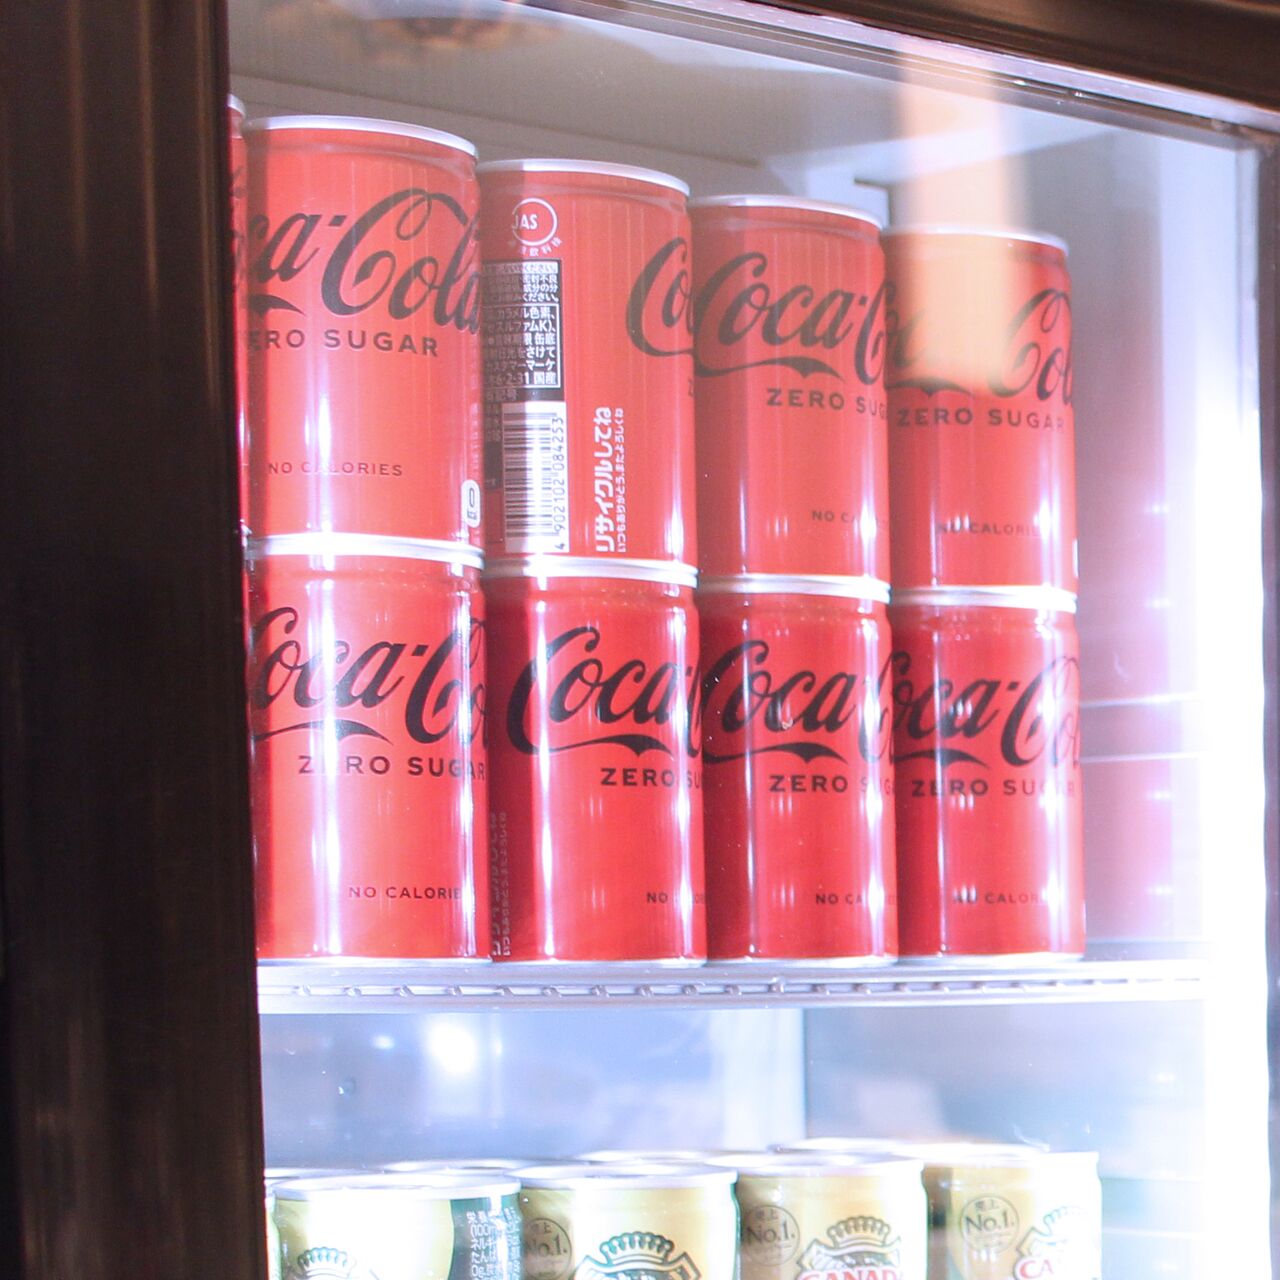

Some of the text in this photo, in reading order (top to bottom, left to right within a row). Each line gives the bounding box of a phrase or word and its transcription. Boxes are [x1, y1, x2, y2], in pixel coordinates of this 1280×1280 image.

[324, 330, 438, 358] SUGAR
[766, 388, 846, 411] ZERO
[896, 408, 1065, 432] ZERO SUGAR
[552, 416, 565, 472] 084253
[267, 462, 404, 478] NO CALORIES
[594, 406, 614, 553] リサイクルしてね
[553, 478, 566, 532] 902102
[811, 509, 836, 522] NO
[298, 755, 487, 781] ZRO SUGAR
[600, 768, 674, 788] ZERO
[769, 774, 849, 793] ZERO
[911, 779, 990, 798] ZERO
[349, 885, 462, 900] NO CALORIE
[647, 892, 669, 904] NO
[815, 893, 839, 905] NO
